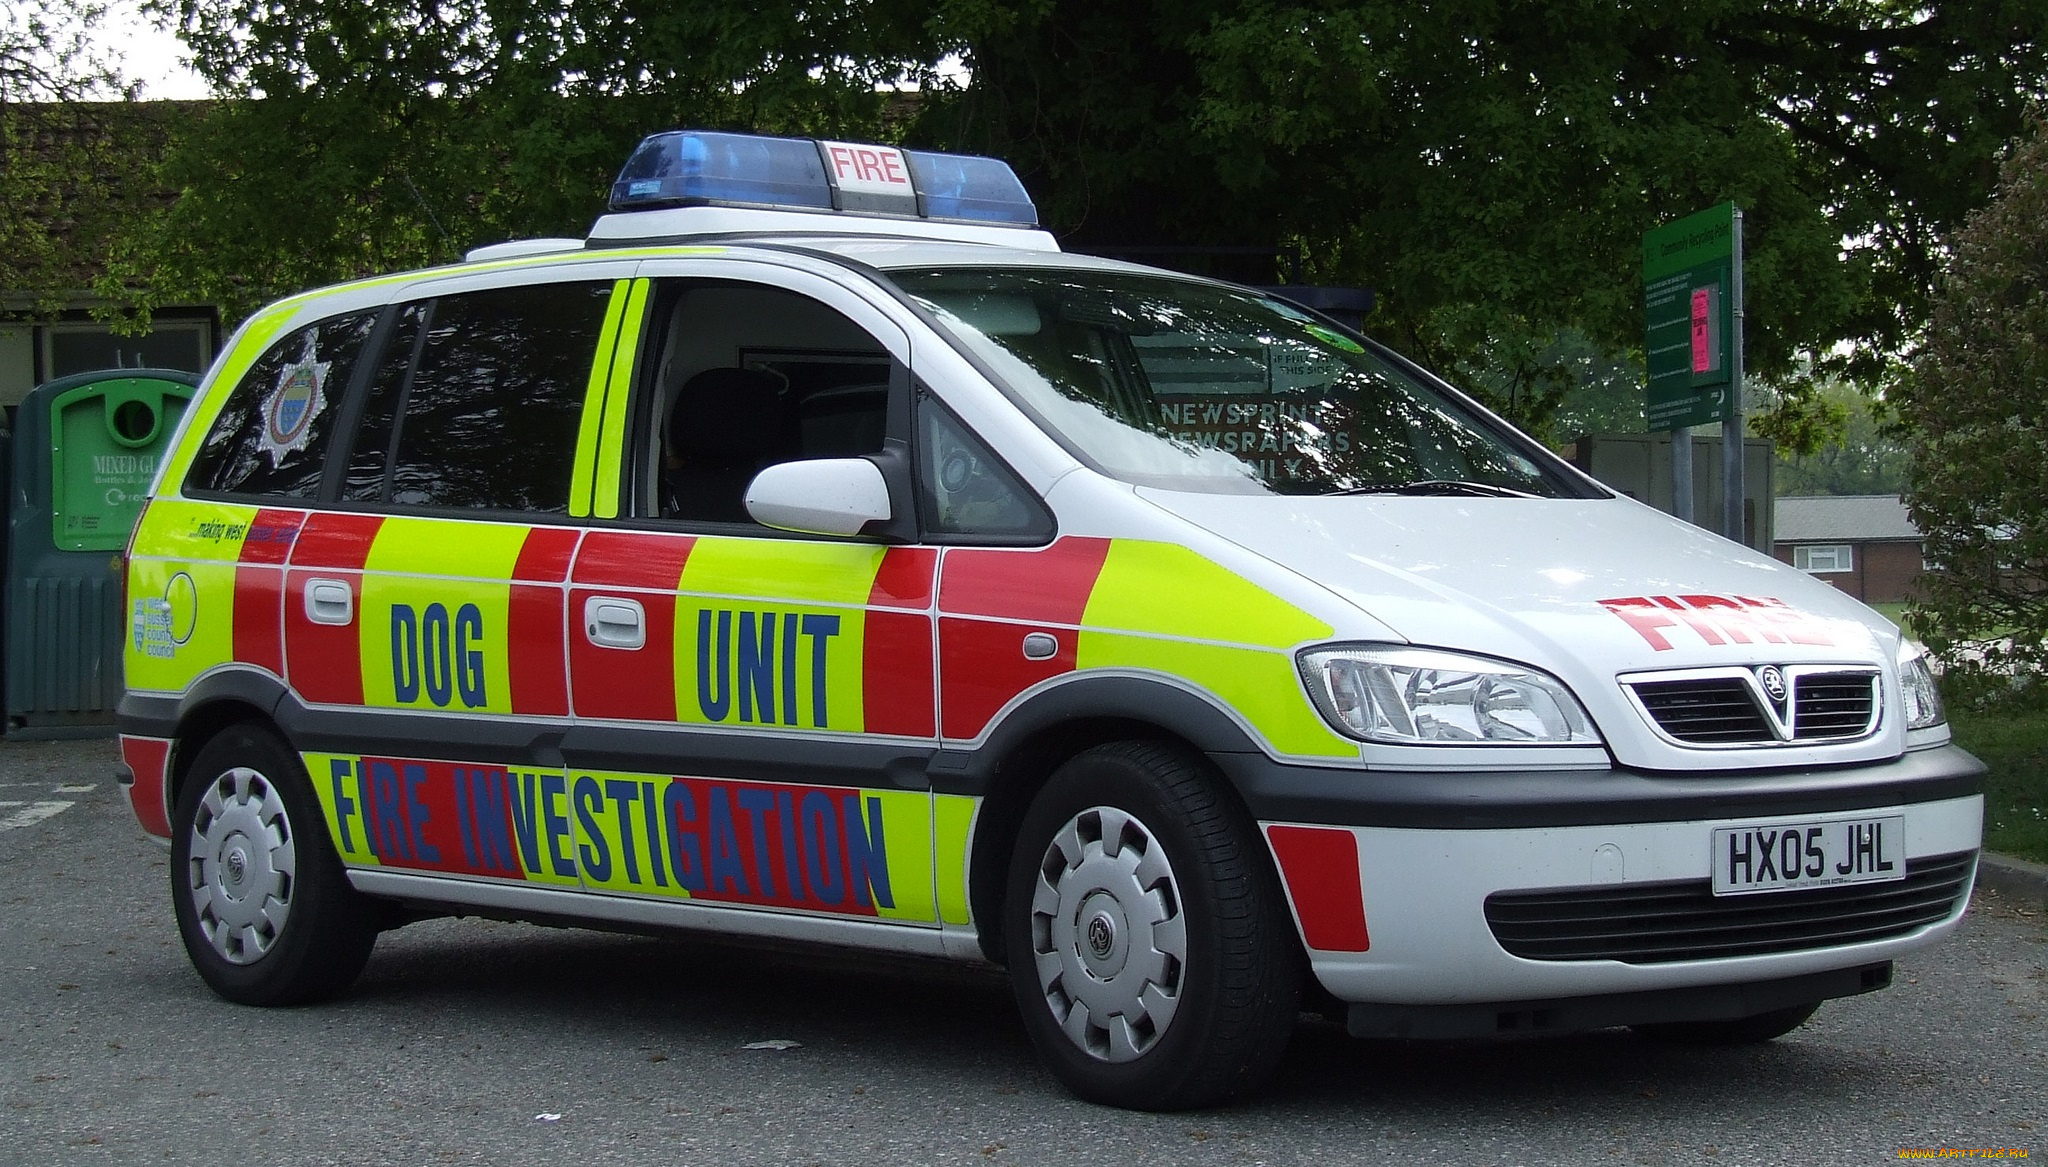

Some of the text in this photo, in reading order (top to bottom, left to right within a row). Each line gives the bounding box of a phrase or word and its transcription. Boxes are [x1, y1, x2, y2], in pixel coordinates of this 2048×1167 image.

[829, 147, 908, 185] FIRE
[1279, 366, 1304, 374] THIS
[1160, 402, 1324, 425] NEWSPRINT
[94, 455, 157, 474] MIXED GL
[147, 598, 168, 610] wes
[1597, 594, 1834, 651] FIRE
[391, 602, 839, 728] DOG UNIT
[329, 758, 895, 909] FIRE INVESTIGATION
[1730, 822, 1893, 884] HX05 JHL
